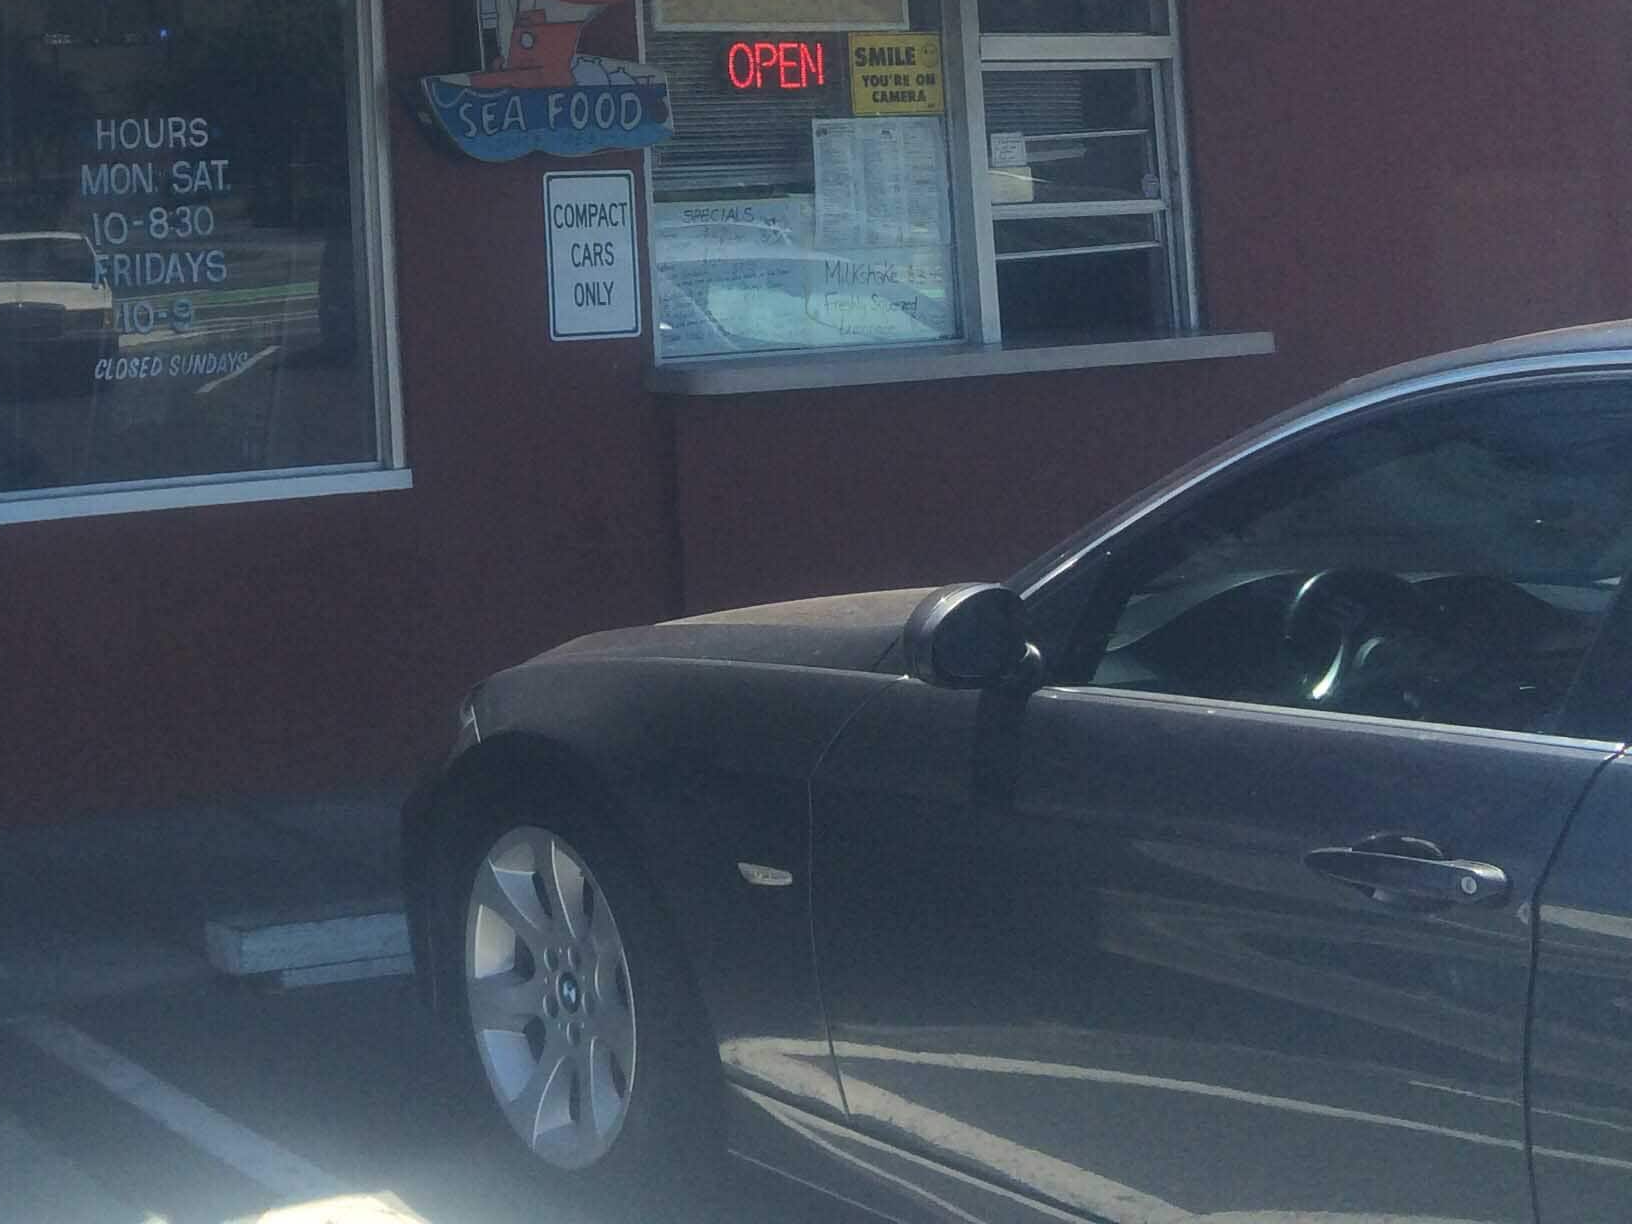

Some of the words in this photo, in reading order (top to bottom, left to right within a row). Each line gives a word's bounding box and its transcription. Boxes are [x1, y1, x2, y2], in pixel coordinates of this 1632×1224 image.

[726, 42, 825, 89] OPEN
[855, 47, 917, 67] SMILE
[862, 74, 910, 88] YOU'RE
[916, 72, 936, 86] ON
[872, 89, 927, 104] CAMERA
[459, 94, 527, 137] SEA
[547, 91, 643, 132] FOOD
[96, 117, 209, 151] HOURS
[554, 202, 628, 229] COMPACT
[682, 207, 755, 224] SPECIALS
[571, 241, 615, 267] CARS
[94, 249, 227, 288] FRIDAYS
[574, 281, 615, 307] ONLY
[95, 355, 163, 381] CLOSED
[169, 350, 250, 376] SUNDAYS
